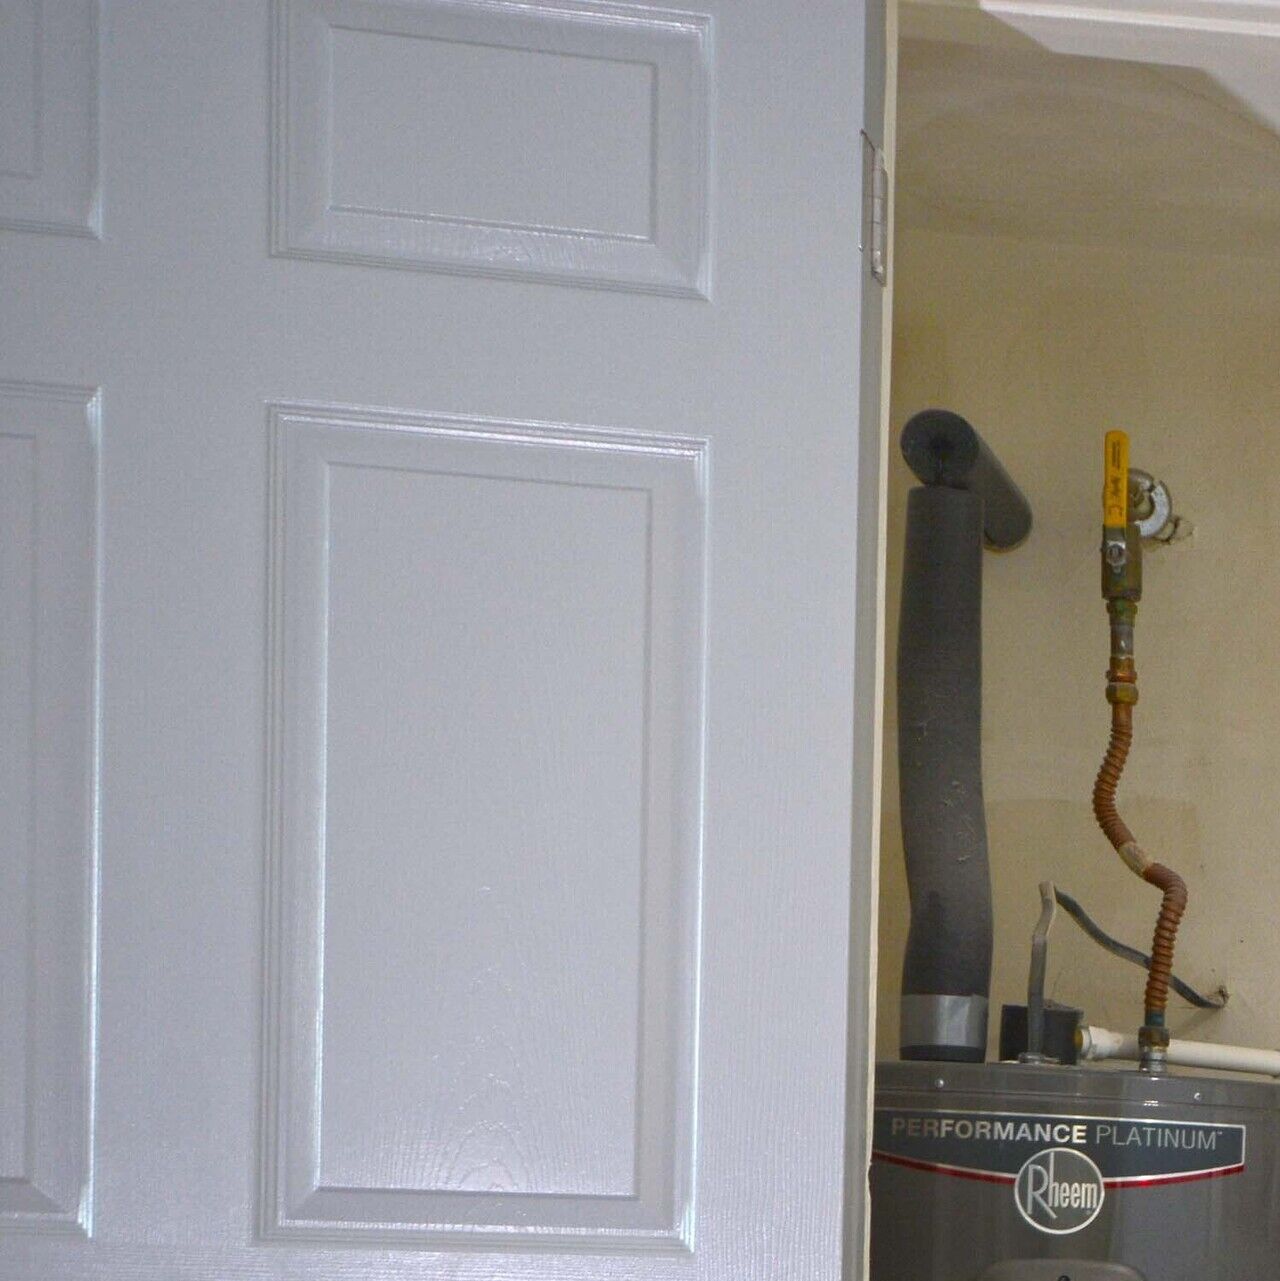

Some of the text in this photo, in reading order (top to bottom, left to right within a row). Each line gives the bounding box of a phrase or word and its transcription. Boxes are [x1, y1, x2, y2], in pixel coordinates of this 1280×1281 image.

[891, 1117, 1217, 1150] PERFORMANCE PLATINUM
[1027, 1152, 1098, 1219] Rheem
